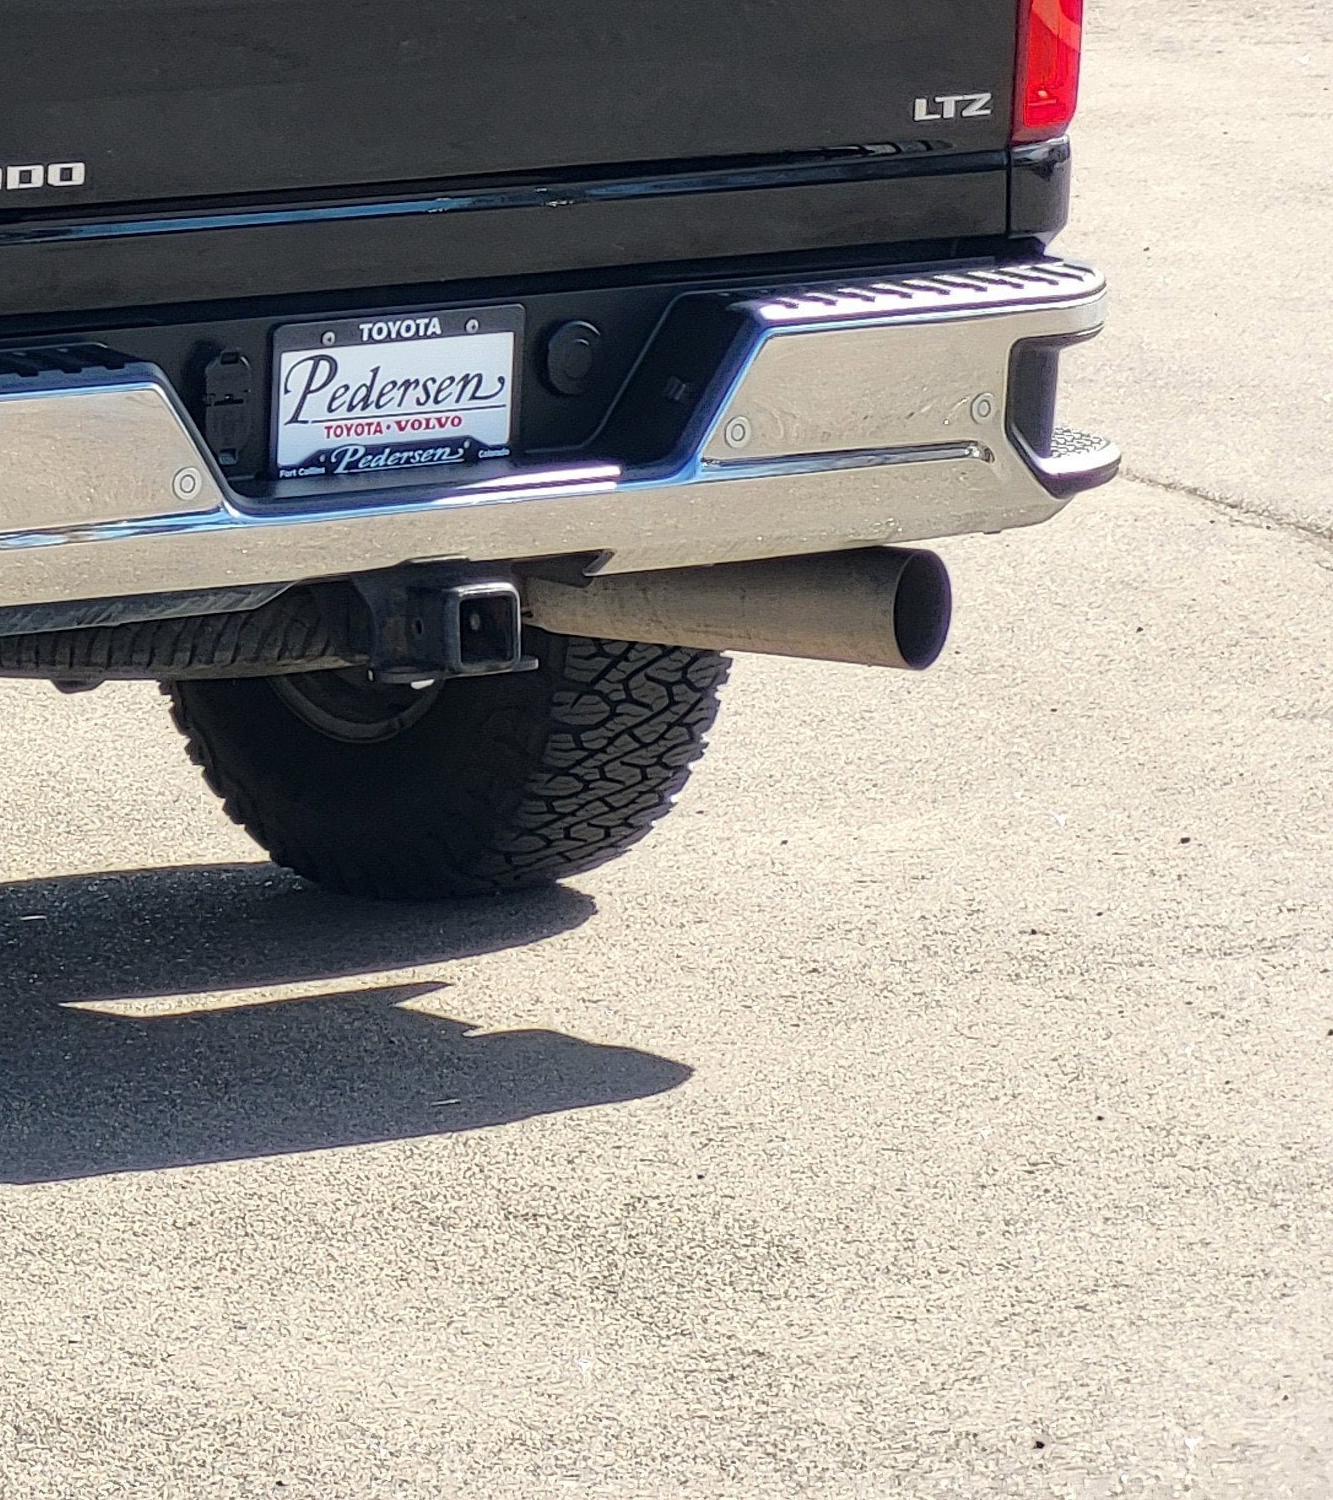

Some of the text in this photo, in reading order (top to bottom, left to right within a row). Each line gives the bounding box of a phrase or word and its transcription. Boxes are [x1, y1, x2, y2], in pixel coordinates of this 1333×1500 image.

[913, 92, 992, 122] LTZ
[359, 317, 442, 341] TOYOTA
[284, 353, 506, 426] Pedersen
[324, 415, 463, 439] TOYOTA VOLVO
[330, 443, 464, 474] Pedersen
[279, 469, 297, 479] Fort
